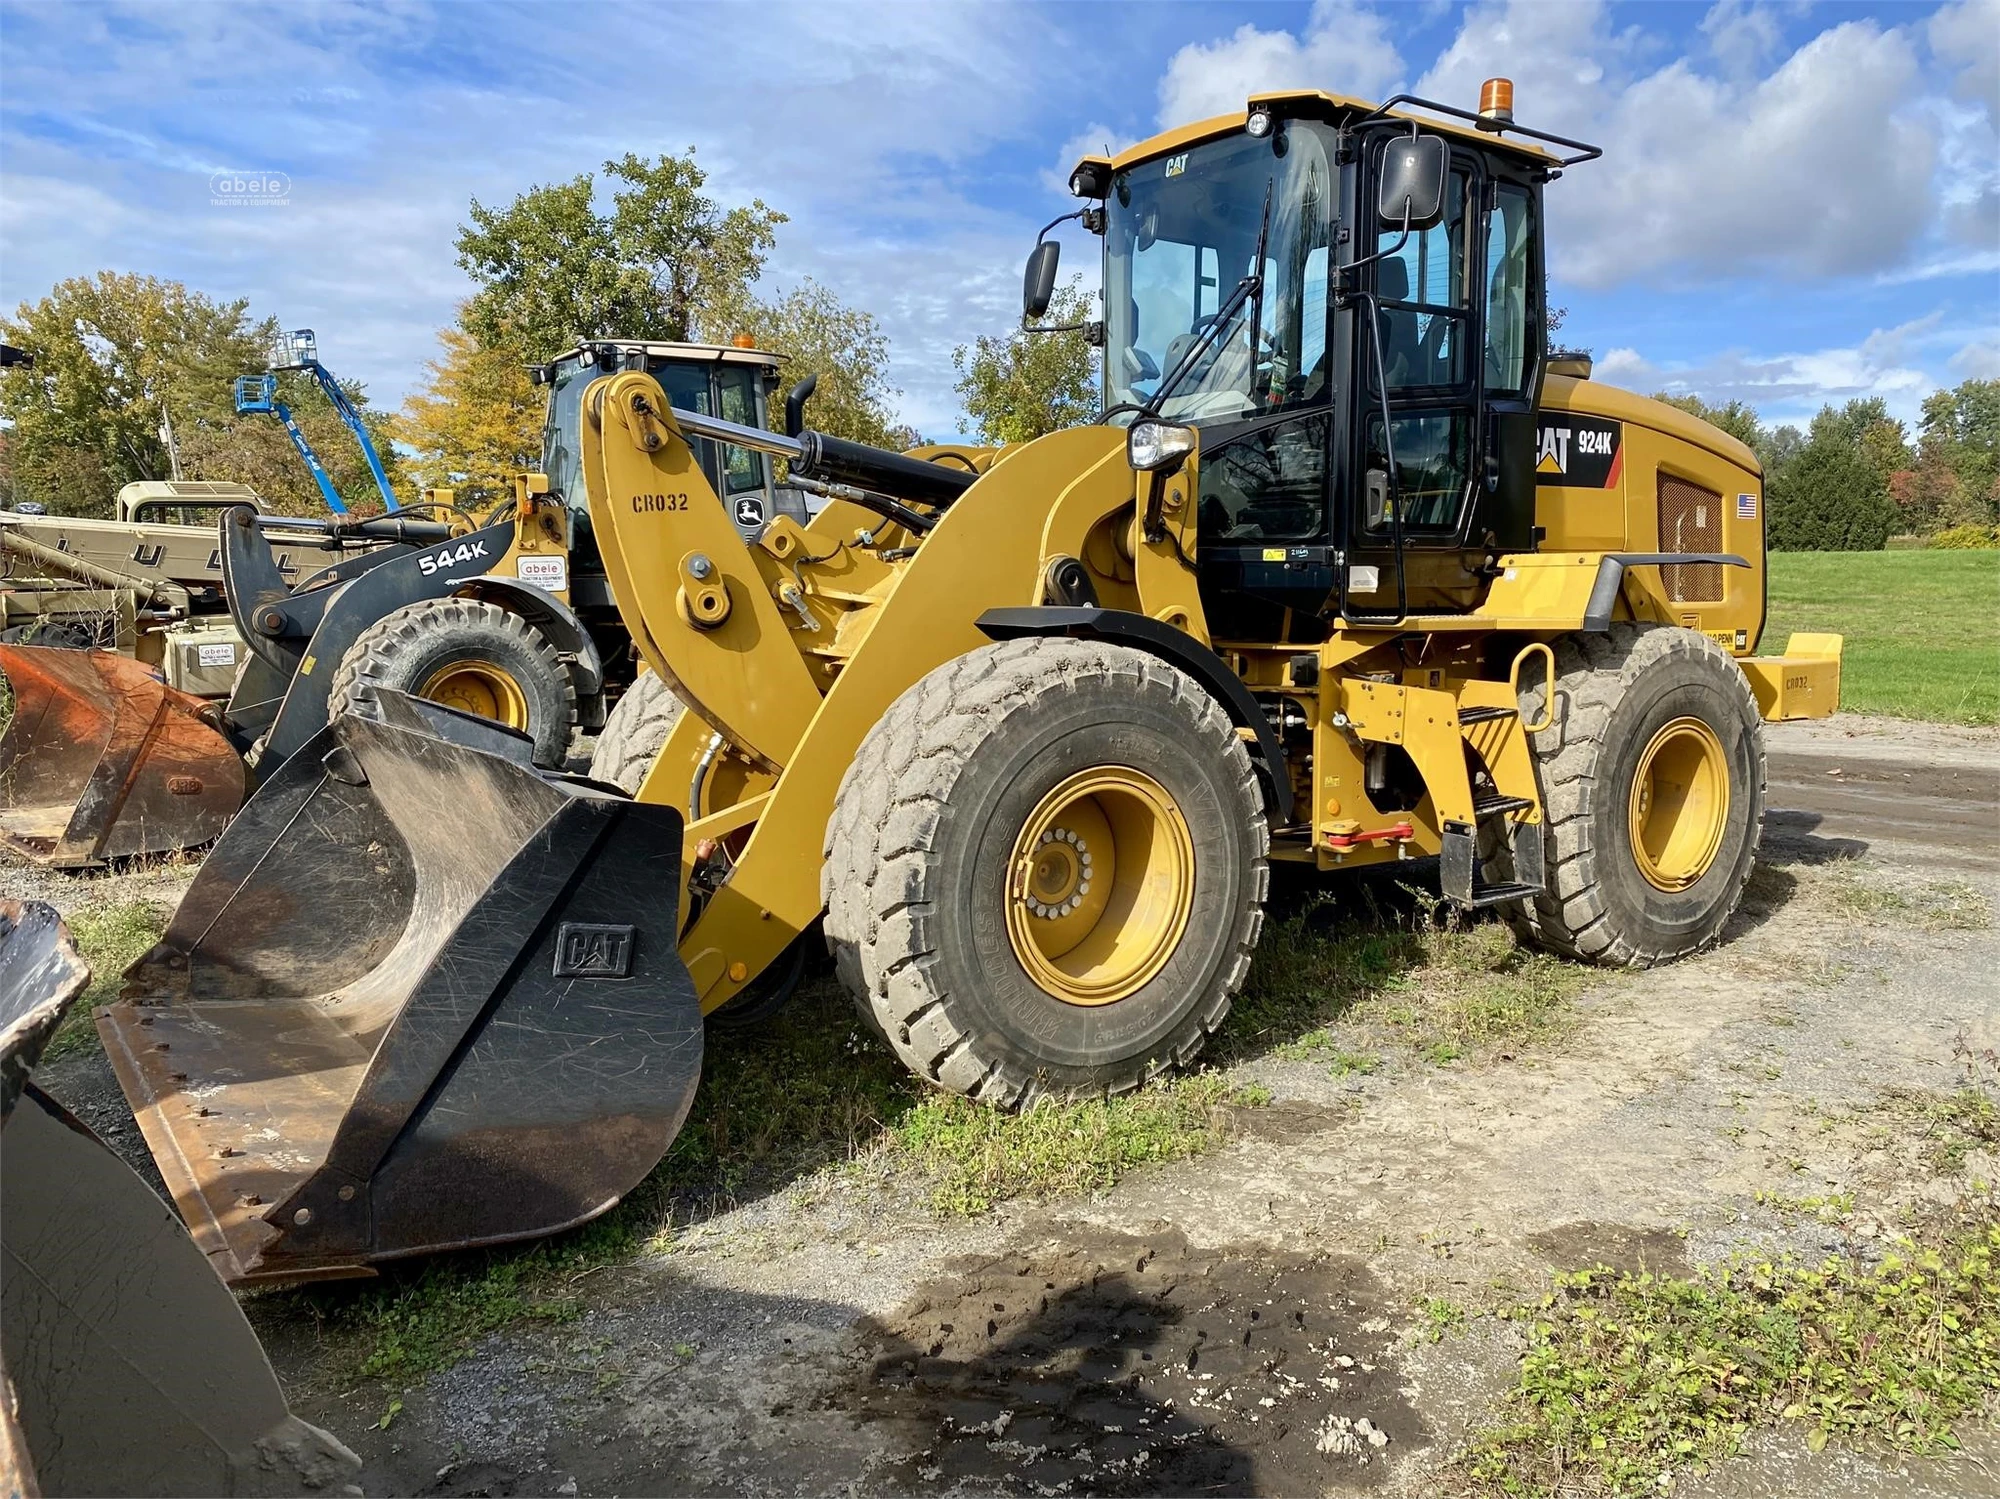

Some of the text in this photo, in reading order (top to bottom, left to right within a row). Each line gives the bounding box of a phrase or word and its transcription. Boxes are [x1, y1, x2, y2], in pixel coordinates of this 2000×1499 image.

[1165, 153, 1189, 177] CAT
[1535, 427, 1613, 474] AT 924K
[417, 538, 490, 577] 544K
[525, 564, 558, 573] abele
[1736, 634, 1746, 645] CAT
[566, 930, 628, 970] CAT
